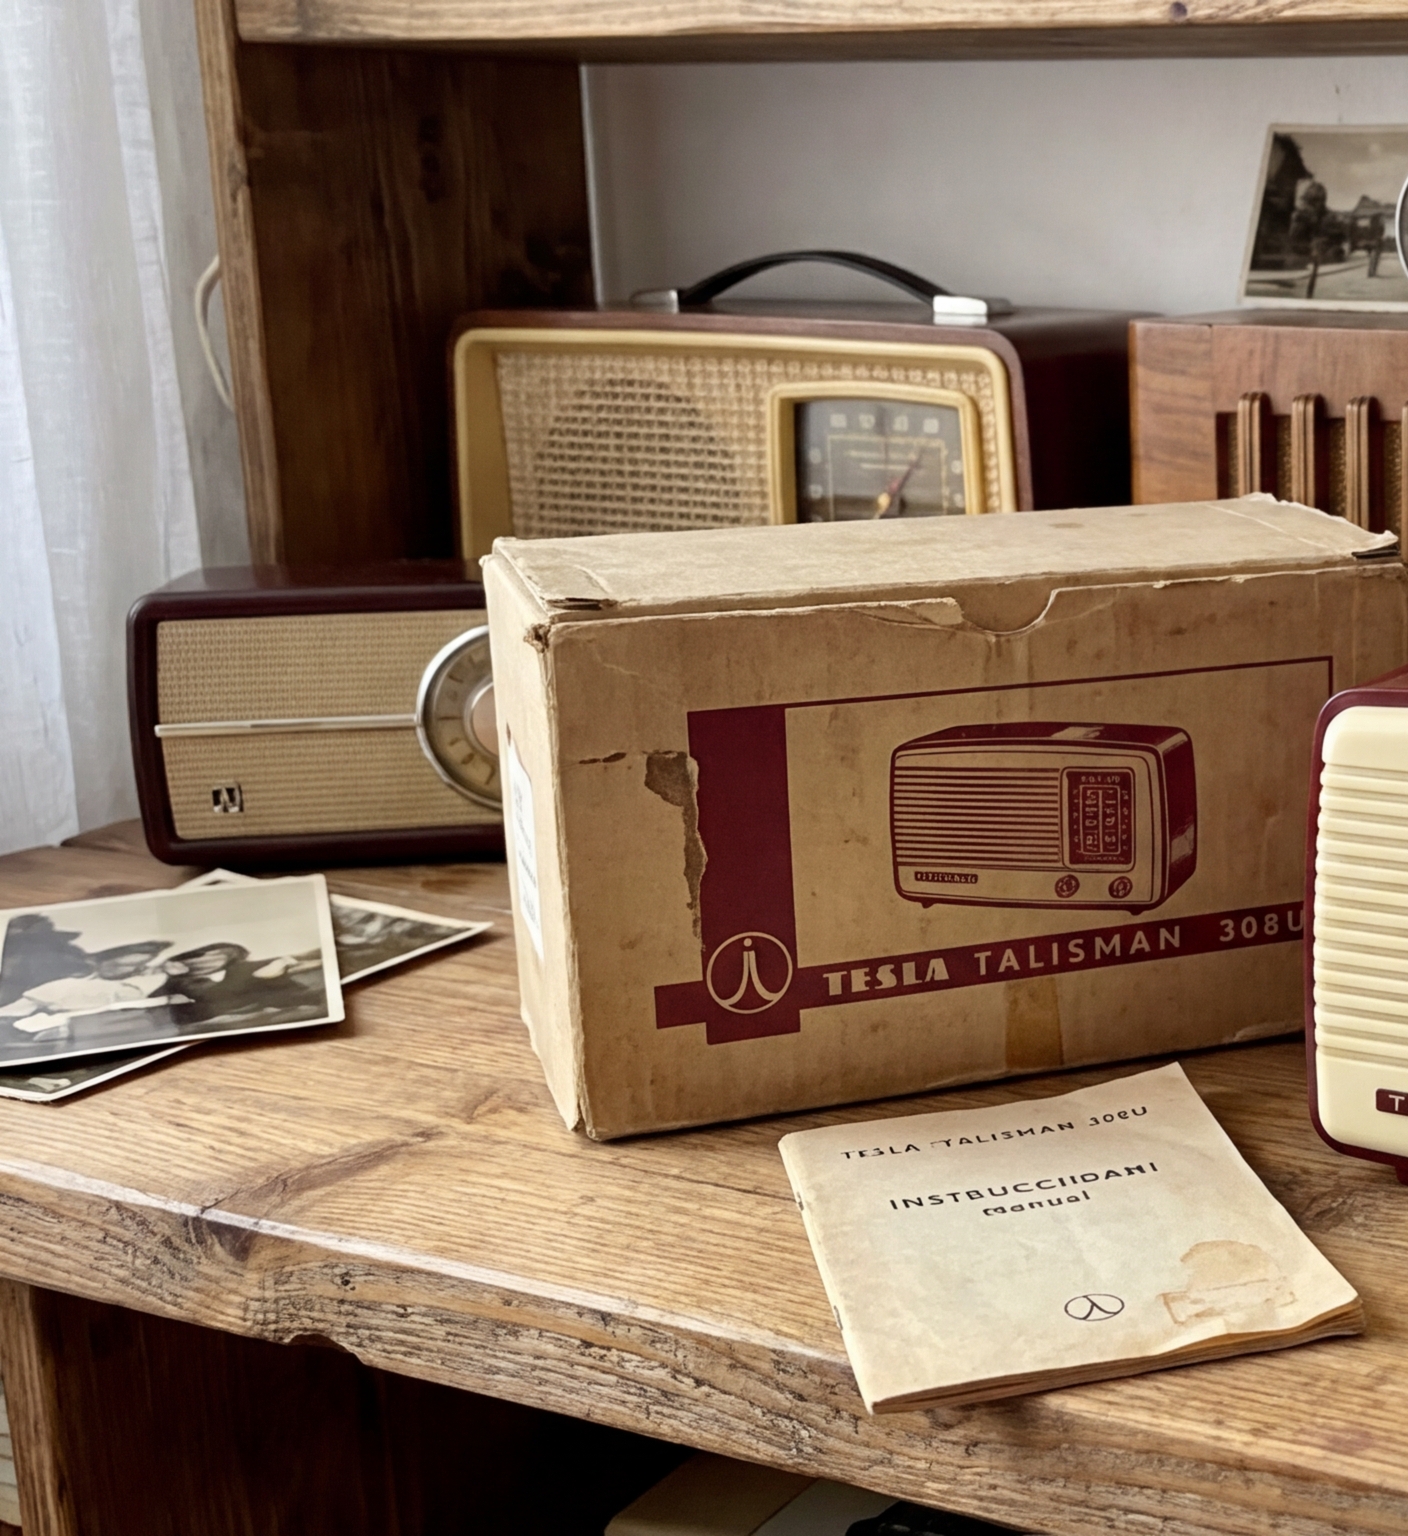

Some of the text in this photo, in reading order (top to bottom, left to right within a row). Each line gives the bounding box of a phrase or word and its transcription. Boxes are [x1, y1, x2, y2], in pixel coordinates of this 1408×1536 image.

[823, 908, 1304, 996] TESLA TALISMAN 308U
